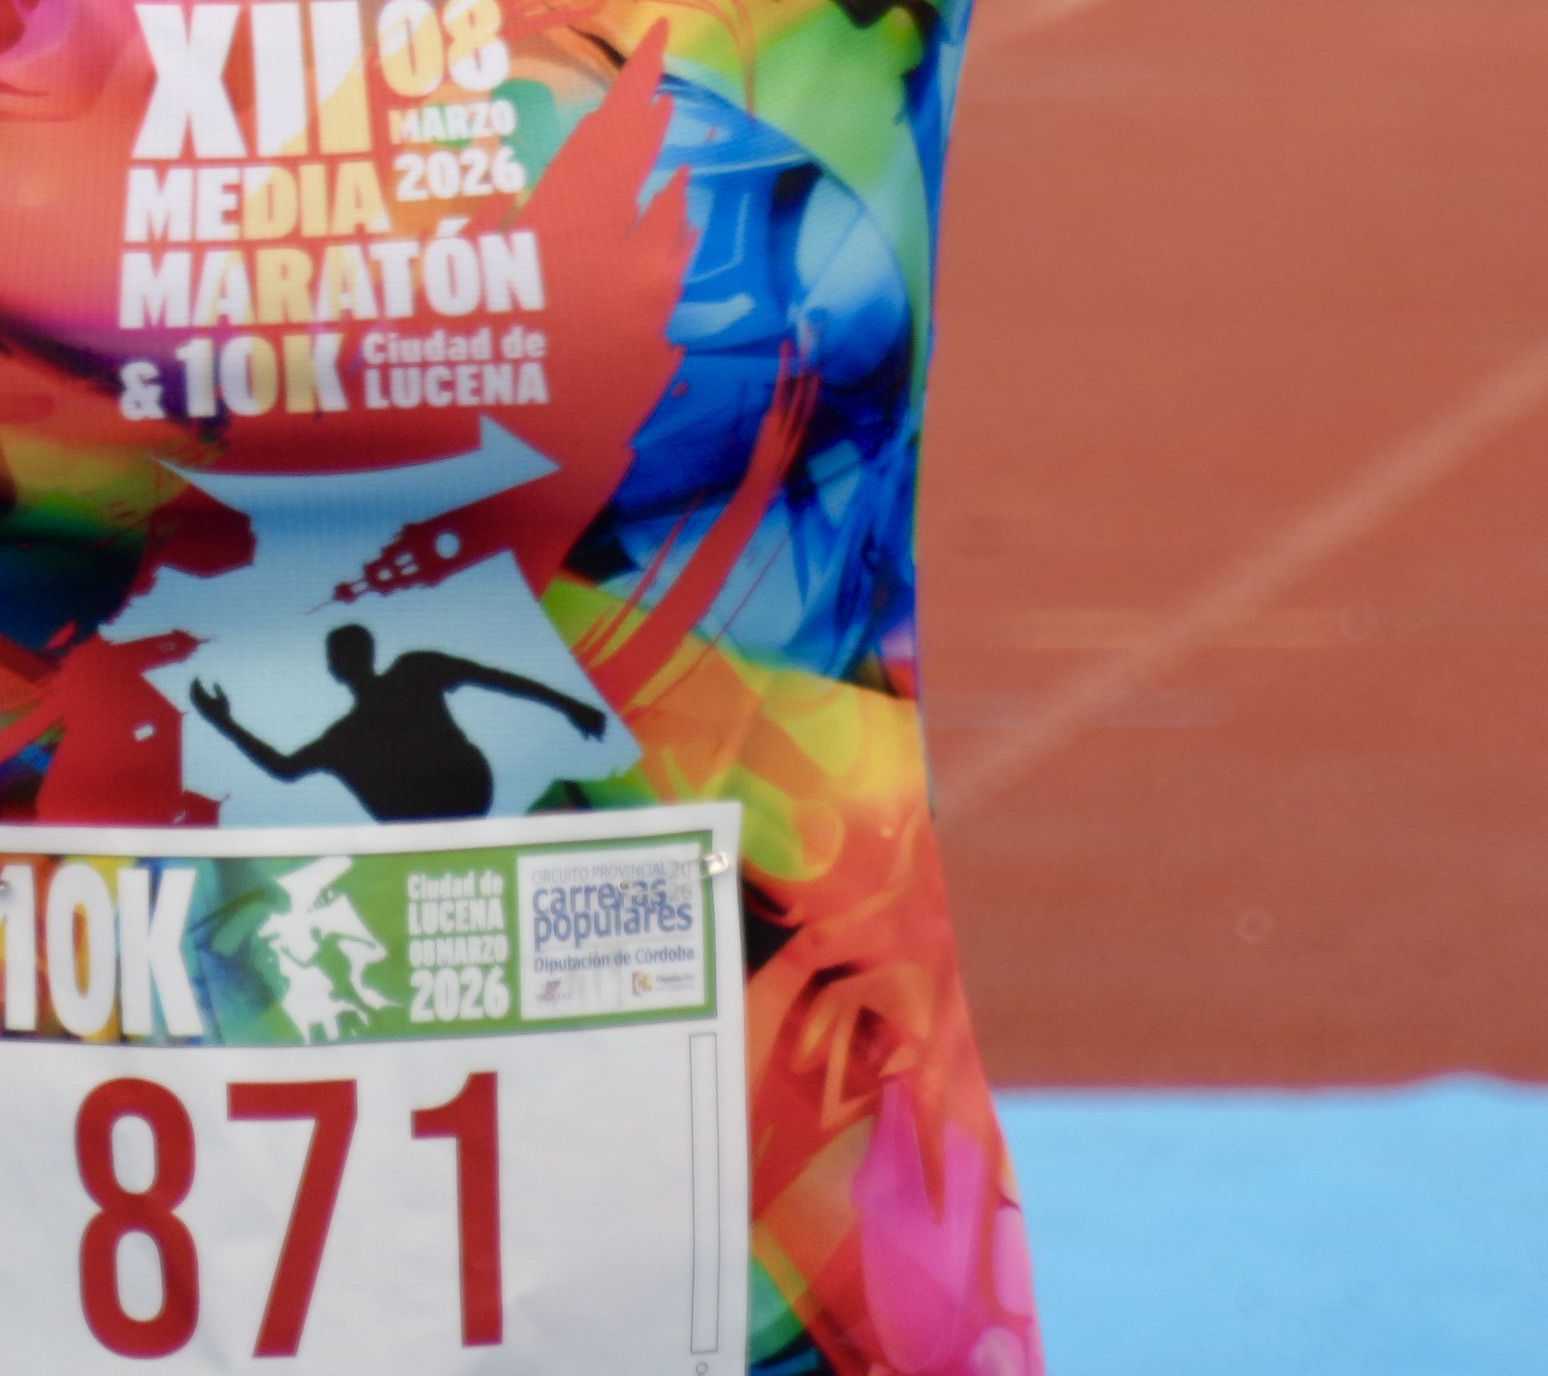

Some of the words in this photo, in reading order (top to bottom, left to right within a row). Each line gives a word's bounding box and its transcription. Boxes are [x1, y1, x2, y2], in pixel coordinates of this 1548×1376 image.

[131, 0, 373, 160] XII
[388, 99, 517, 144] MARZO
[123, 160, 392, 243] MEDIA
[393, 146, 526, 203] 2026
[118, 218, 546, 330] MARATÓN
[362, 328, 491, 364] Ciudad
[500, 325, 547, 359] de
[118, 361, 166, 421] &
[176, 331, 350, 419] 10K
[363, 359, 550, 410] LUCENA
[408, 870, 475, 899] Ciudad
[480, 869, 504, 896] de
[408, 898, 505, 935] LUCENA
[534, 901, 694, 952] populares
[534, 950, 610, 975] Diputación
[614, 949, 631, 966] de
[635, 945, 695, 963] Córdoba
[410, 966, 510, 1023] 2026
[74, 1071, 504, 1361] 871
